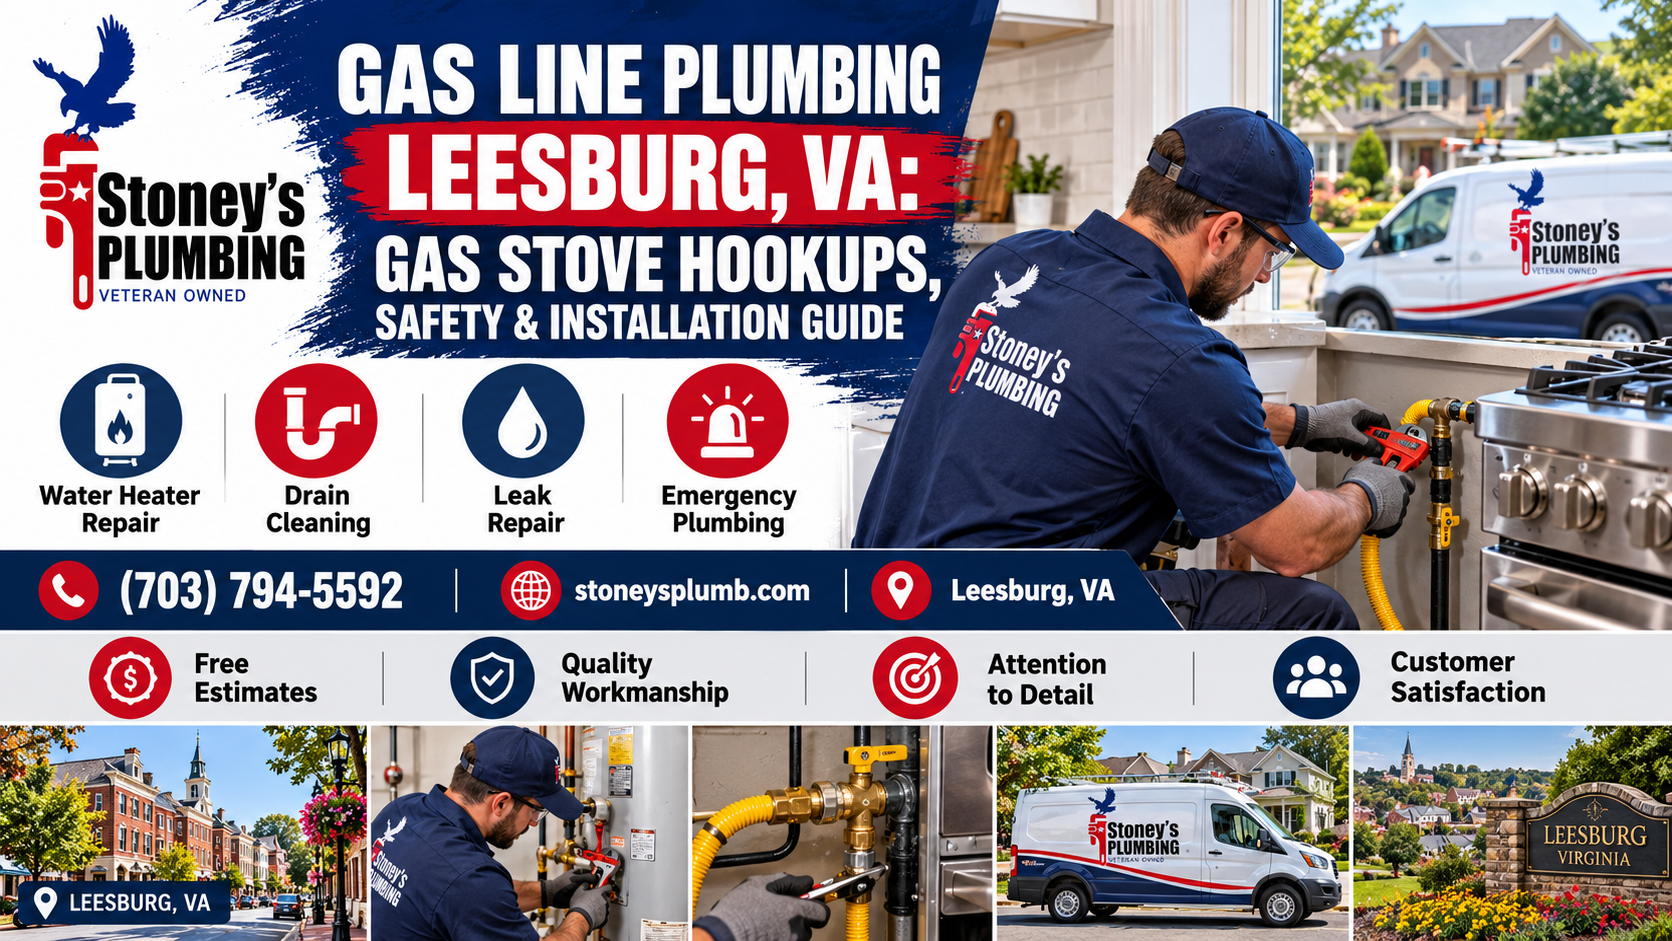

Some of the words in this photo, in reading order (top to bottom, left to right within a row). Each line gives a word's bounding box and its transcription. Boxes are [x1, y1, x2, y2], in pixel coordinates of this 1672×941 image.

[1532, 218, 1620, 244] Stoney's
[1532, 244, 1620, 264] PLUMBING
[980, 325, 1071, 384] Stoney's
[965, 357, 1062, 418] PLUMBING
[1107, 820, 1179, 840] Stoney's
[1544, 824, 1647, 846] LEESBURG
[1108, 839, 1179, 855] PLUMBING
[1557, 850, 1631, 866] VIRGINIA
[373, 850, 408, 888] Stoney's
